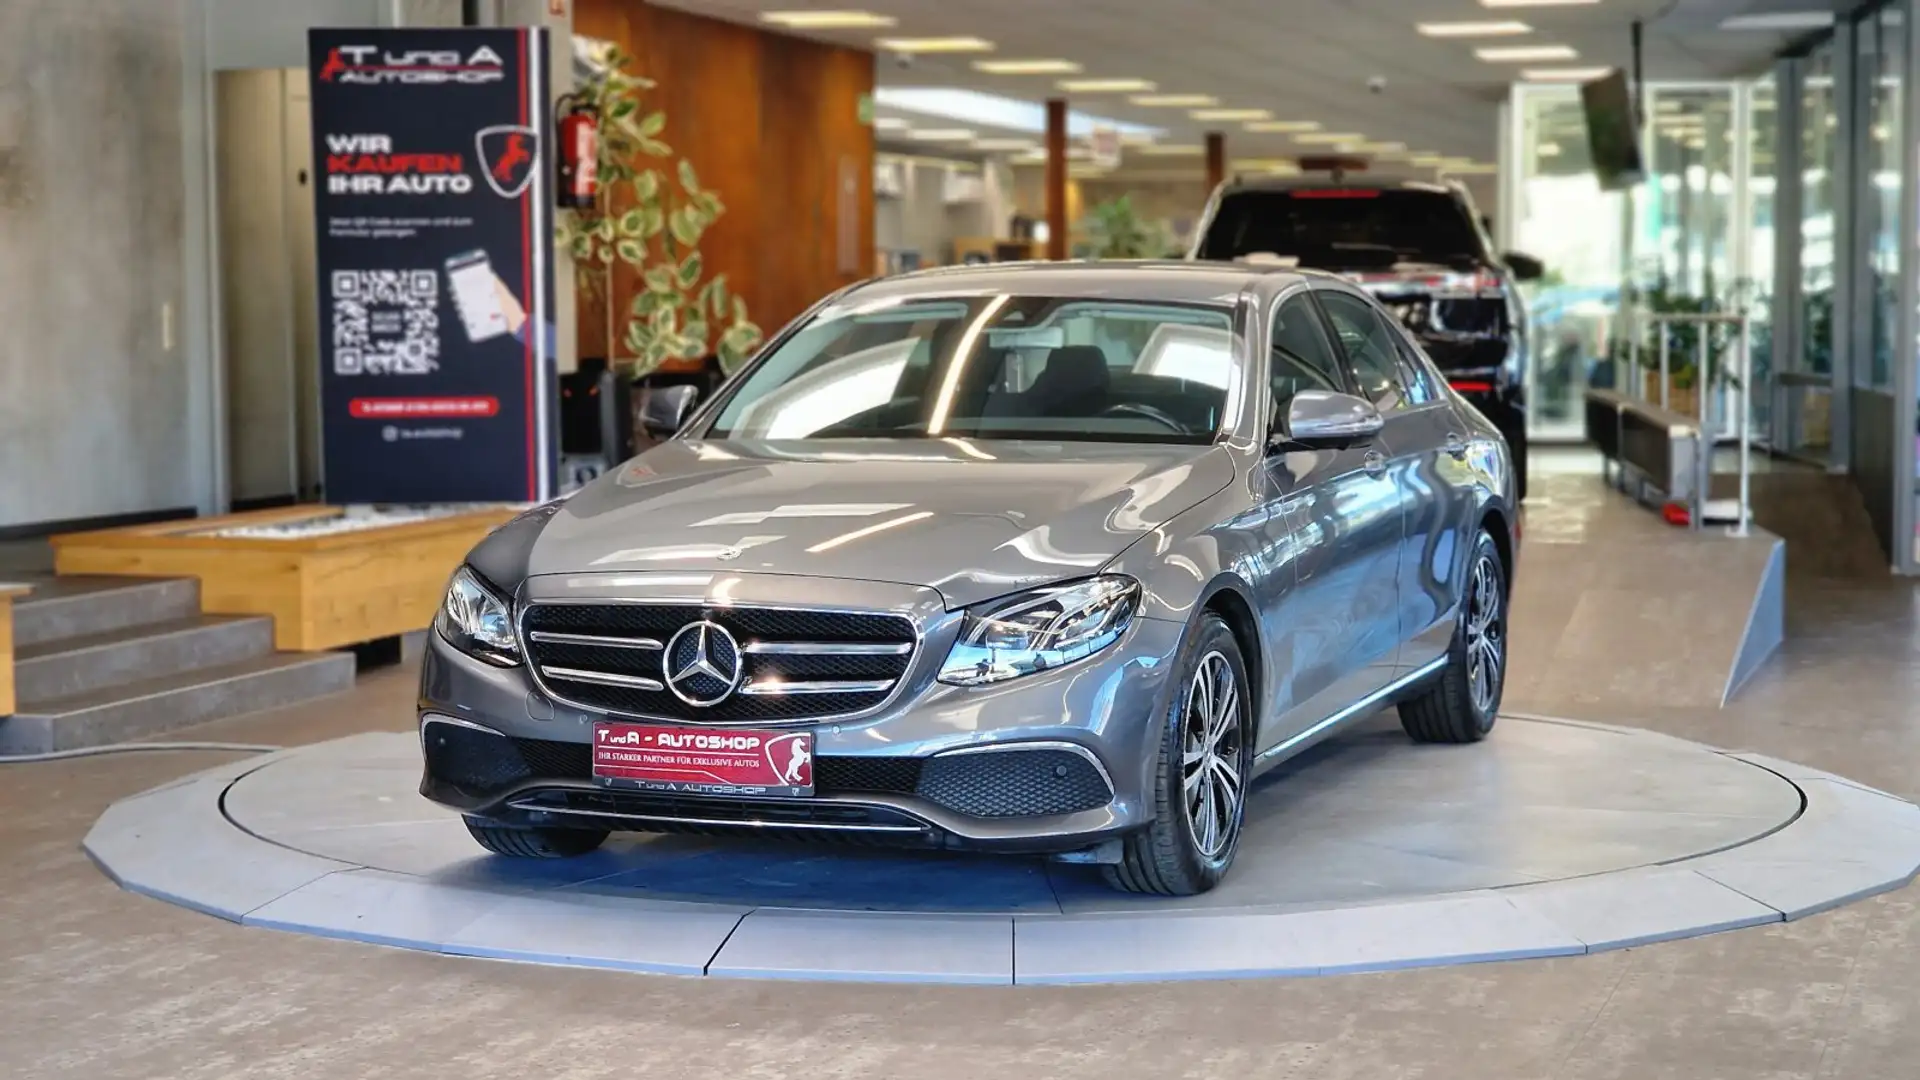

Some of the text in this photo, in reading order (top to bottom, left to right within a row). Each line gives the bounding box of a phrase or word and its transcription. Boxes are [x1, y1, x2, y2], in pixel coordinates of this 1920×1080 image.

[339, 45, 503, 65] T und A
[339, 69, 505, 83] AUTOSHOP
[326, 133, 392, 154] WIR
[327, 153, 462, 174] KAUFEN
[328, 173, 473, 194] IHR AUTO
[658, 733, 760, 751] AUTOSHOP
[598, 752, 611, 760] IHR
[612, 752, 642, 762] STARKER
[643, 754, 676, 765] PARTNER
[692, 757, 733, 767] EXKLUSIVE
[734, 759, 760, 768] AUTOS
[681, 783, 767, 795] AUTOSHOP
